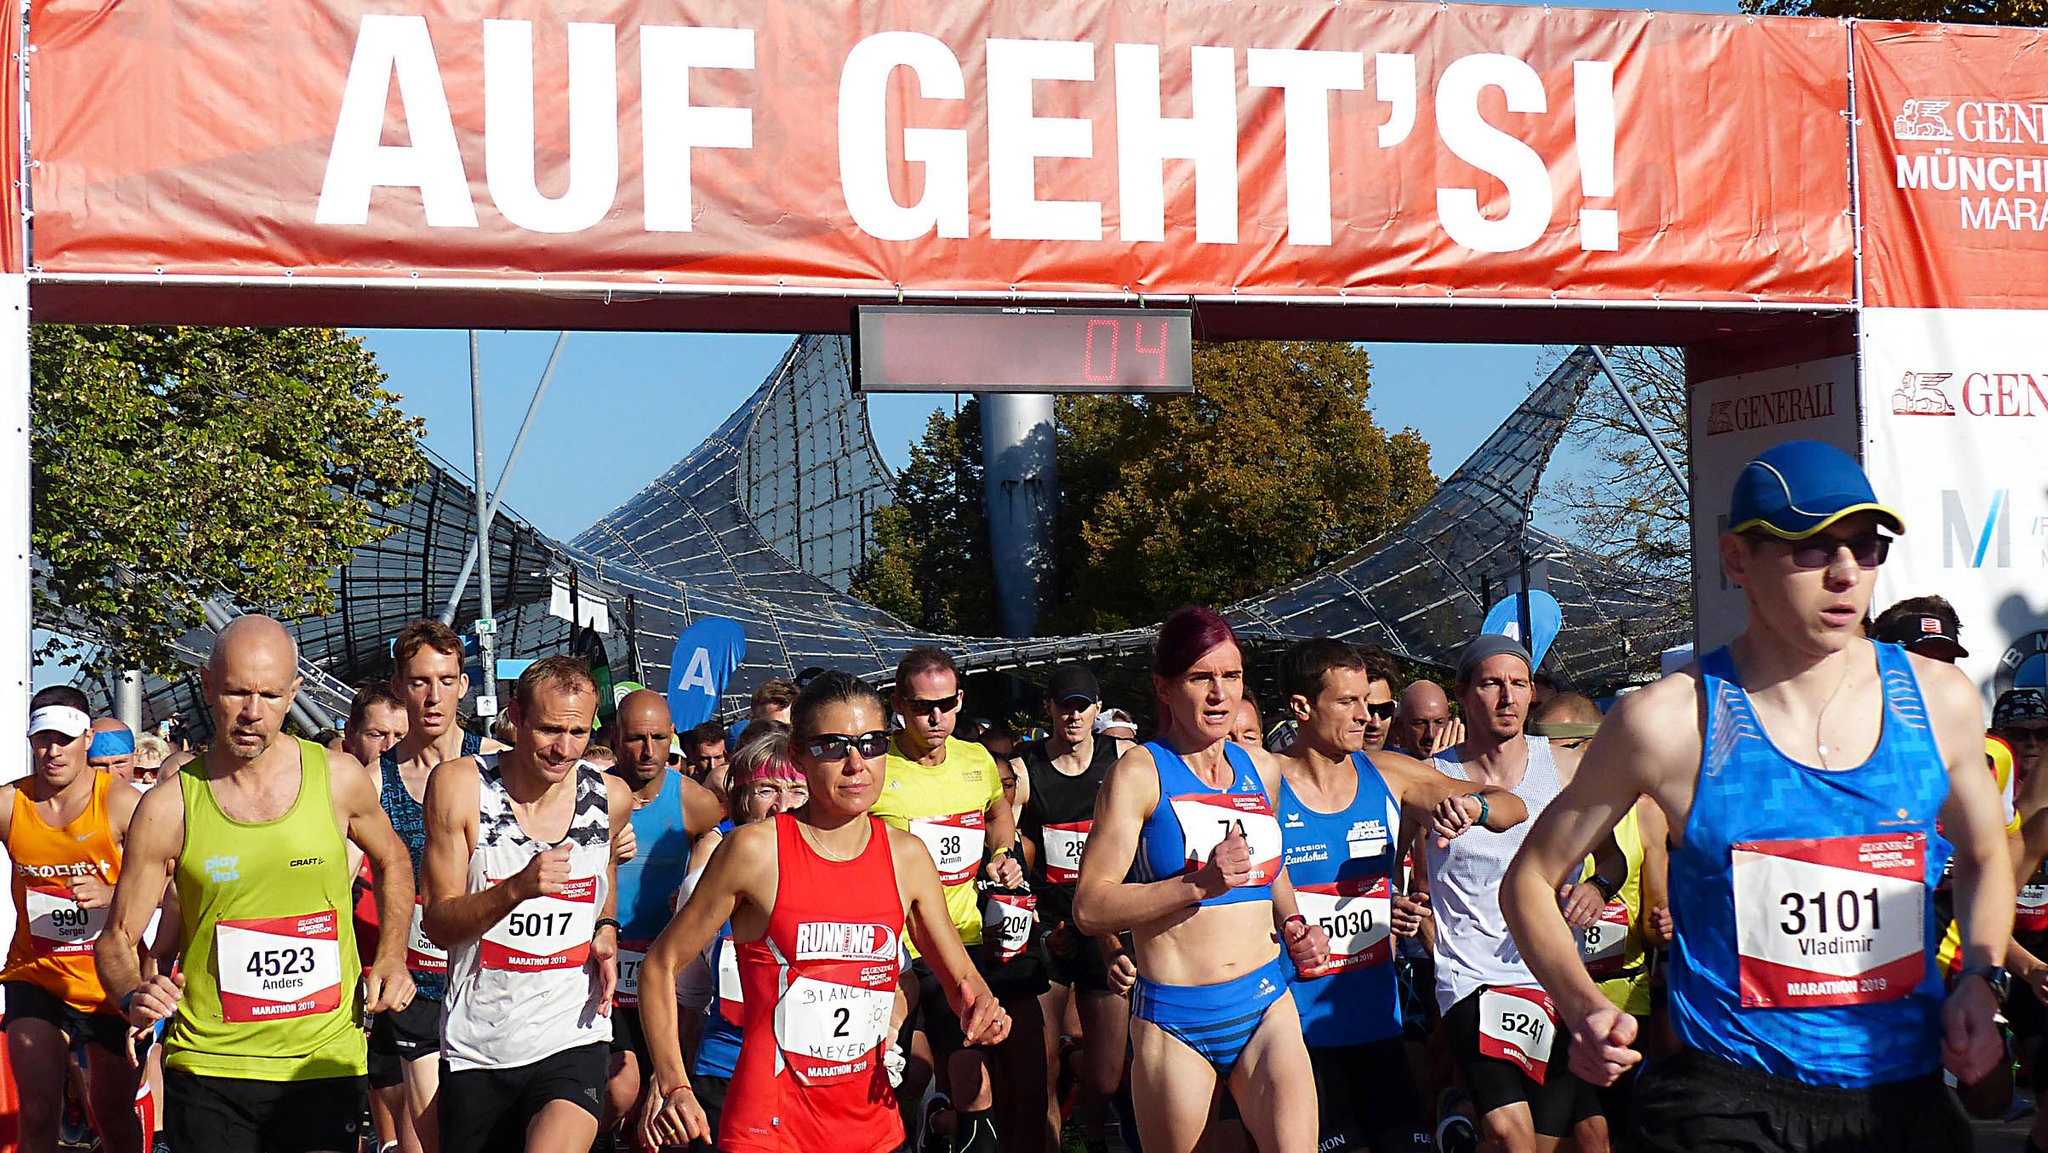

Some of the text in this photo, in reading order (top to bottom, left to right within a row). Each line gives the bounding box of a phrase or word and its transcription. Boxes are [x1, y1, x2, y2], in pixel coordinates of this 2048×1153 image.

[315, 13, 1619, 252] AUF GEHT'S!
[1084, 319, 1169, 383] 04
[1735, 386, 1835, 431] GENERALI
[678, 646, 716, 697] A
[1351, 820, 1380, 830] SPORT
[940, 836, 961, 856] 38
[1295, 843, 1327, 852] REGION
[290, 858, 317, 867] CRAFT
[939, 855, 962, 866] Armin
[1283, 851, 1329, 866] Landshut
[51, 909, 89, 928] 990
[1779, 888, 1881, 936] 3101
[58, 927, 86, 937] Sergei
[508, 912, 573, 937] 5017
[1002, 915, 1028, 934] 204
[1319, 908, 1373, 939] 5030
[796, 924, 876, 954] RUNNING
[1798, 935, 1874, 956] Vladimir
[246, 946, 315, 978] 4523
[508, 956, 567, 966] MARATHON 2019
[262, 977, 304, 991] Anders
[1787, 978, 1888, 996] MARATHON 2019
[802, 986, 872, 1005] BIANCA
[251, 1000, 316, 1016] MARATHON 2019
[833, 1007, 850, 1038] 2
[1501, 1012, 1545, 1045] 5241
[809, 1042, 866, 1060] MEYER
[807, 1060, 868, 1077] MARATHON 2019
